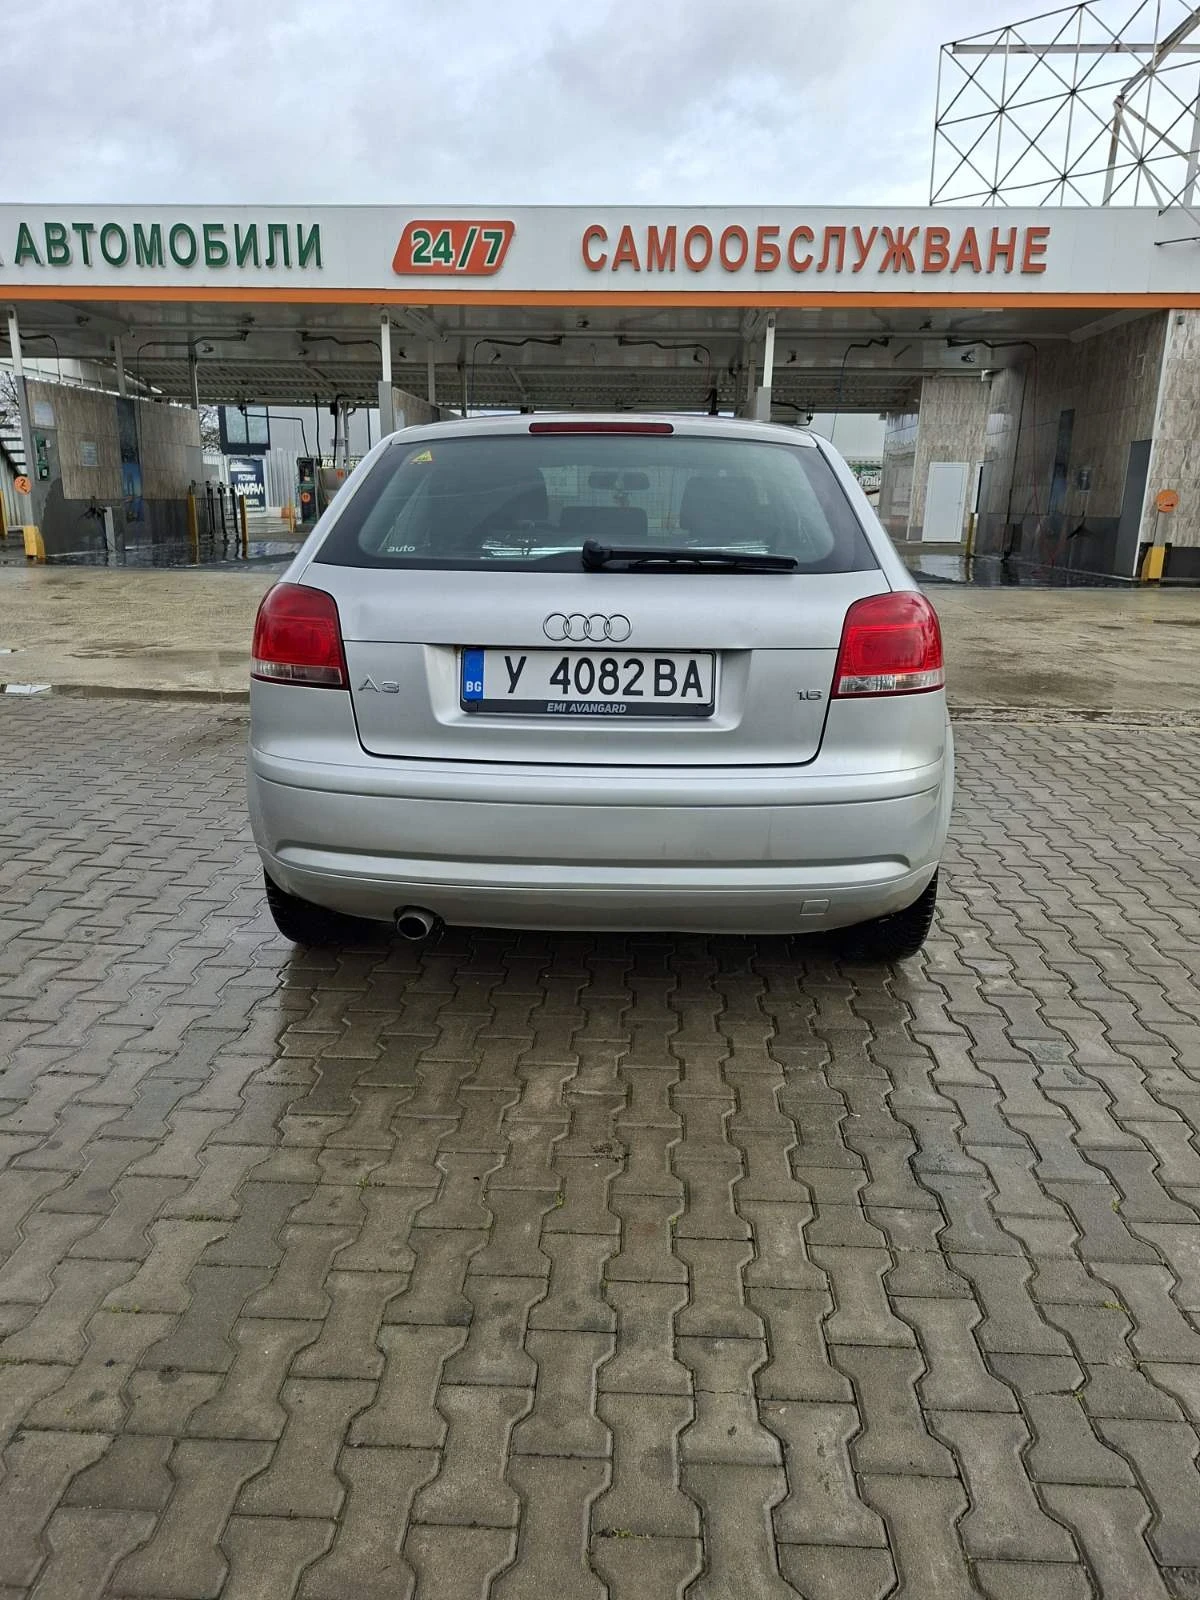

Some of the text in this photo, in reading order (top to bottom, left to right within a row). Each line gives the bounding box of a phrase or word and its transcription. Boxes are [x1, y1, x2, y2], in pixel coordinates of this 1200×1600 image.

[14, 222, 323, 269] АВТОМОБИЛИ
[411, 226, 504, 269] 24/7
[581, 224, 1051, 273] САМООБСЛУЖВАНЕ
[387, 544, 416, 553] auto
[357, 673, 400, 694] A3
[465, 680, 483, 693] BG
[549, 656, 645, 696] 4082
[546, 702, 627, 714] EMI AVANGARD
